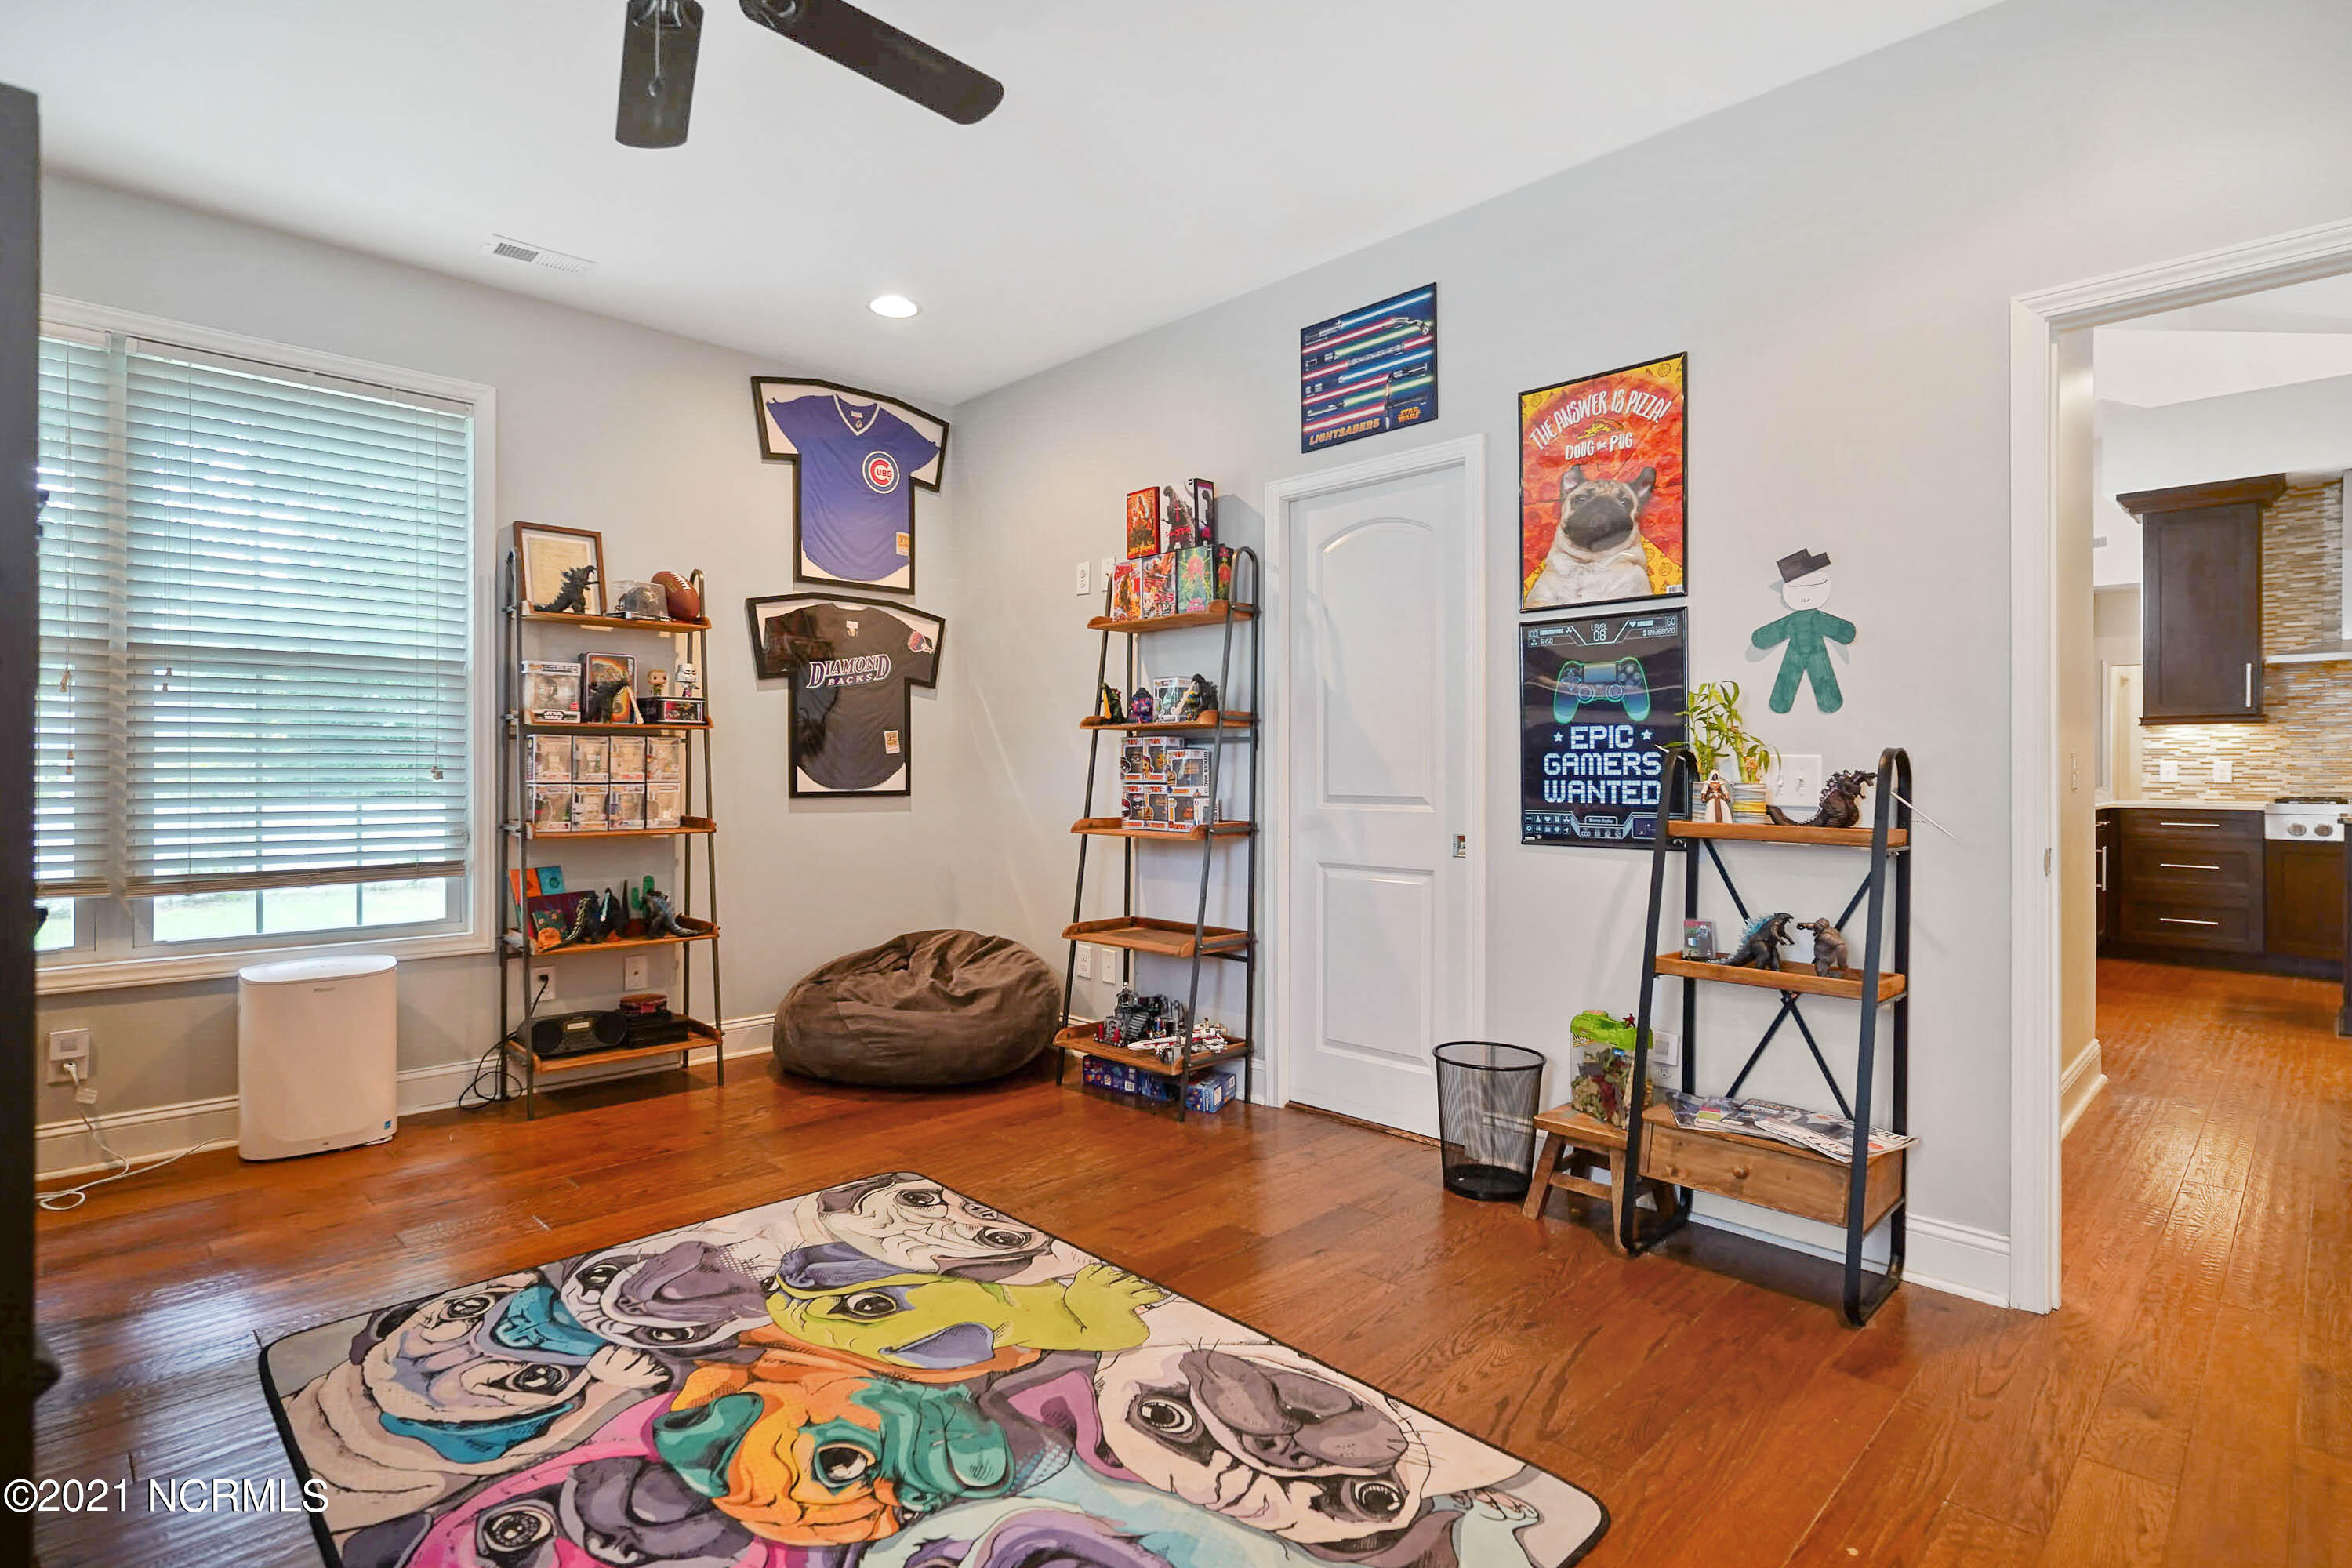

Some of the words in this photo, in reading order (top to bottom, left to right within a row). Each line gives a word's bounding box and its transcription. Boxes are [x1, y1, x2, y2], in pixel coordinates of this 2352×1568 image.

[1309, 418, 1381, 445] LIGHTSABERS
[1530, 418, 1559, 451] THE
[1553, 390, 1607, 433] ANSWER
[1611, 388, 1625, 413] IS
[1626, 390, 1673, 423] PIZZA!
[1565, 439, 1595, 461] DOUG
[1596, 441, 1608, 452] the
[1609, 432, 1633, 452] PUG
[806, 653, 891, 688] DIAMOND
[828, 673, 874, 686] BACKS
[1570, 724, 1634, 750] EPIC
[1544, 751, 1661, 775] GAMERS
[1544, 779, 1661, 804] WANTED
